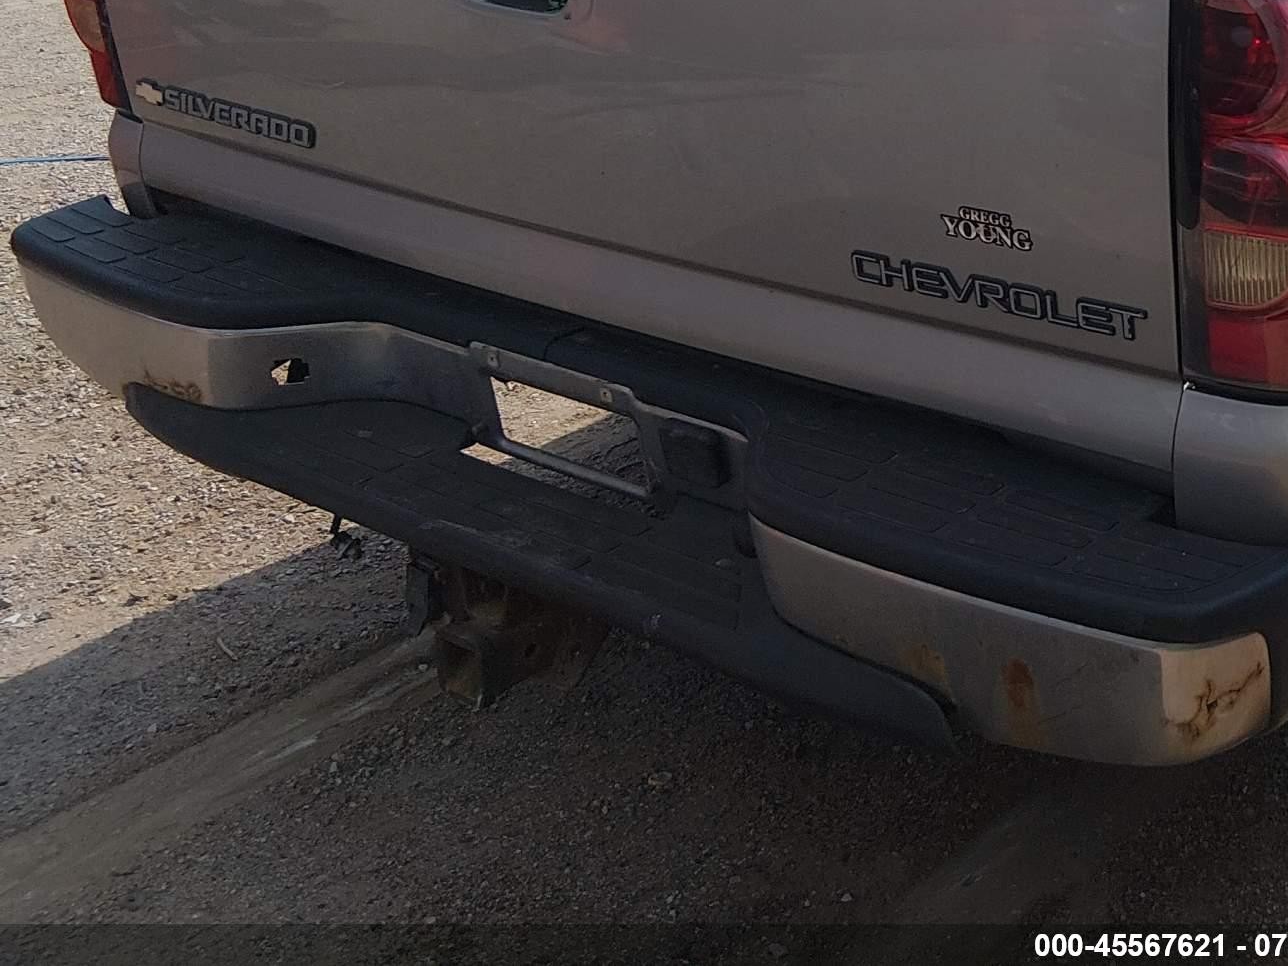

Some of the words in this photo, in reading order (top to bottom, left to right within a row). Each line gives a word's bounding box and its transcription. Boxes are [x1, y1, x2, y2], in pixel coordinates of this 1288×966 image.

[164, 87, 316, 148] SILVERADO
[940, 214, 1033, 251] YOUNG
[959, 206, 1012, 229] GREGG
[850, 249, 1148, 340] CHEVROLET
